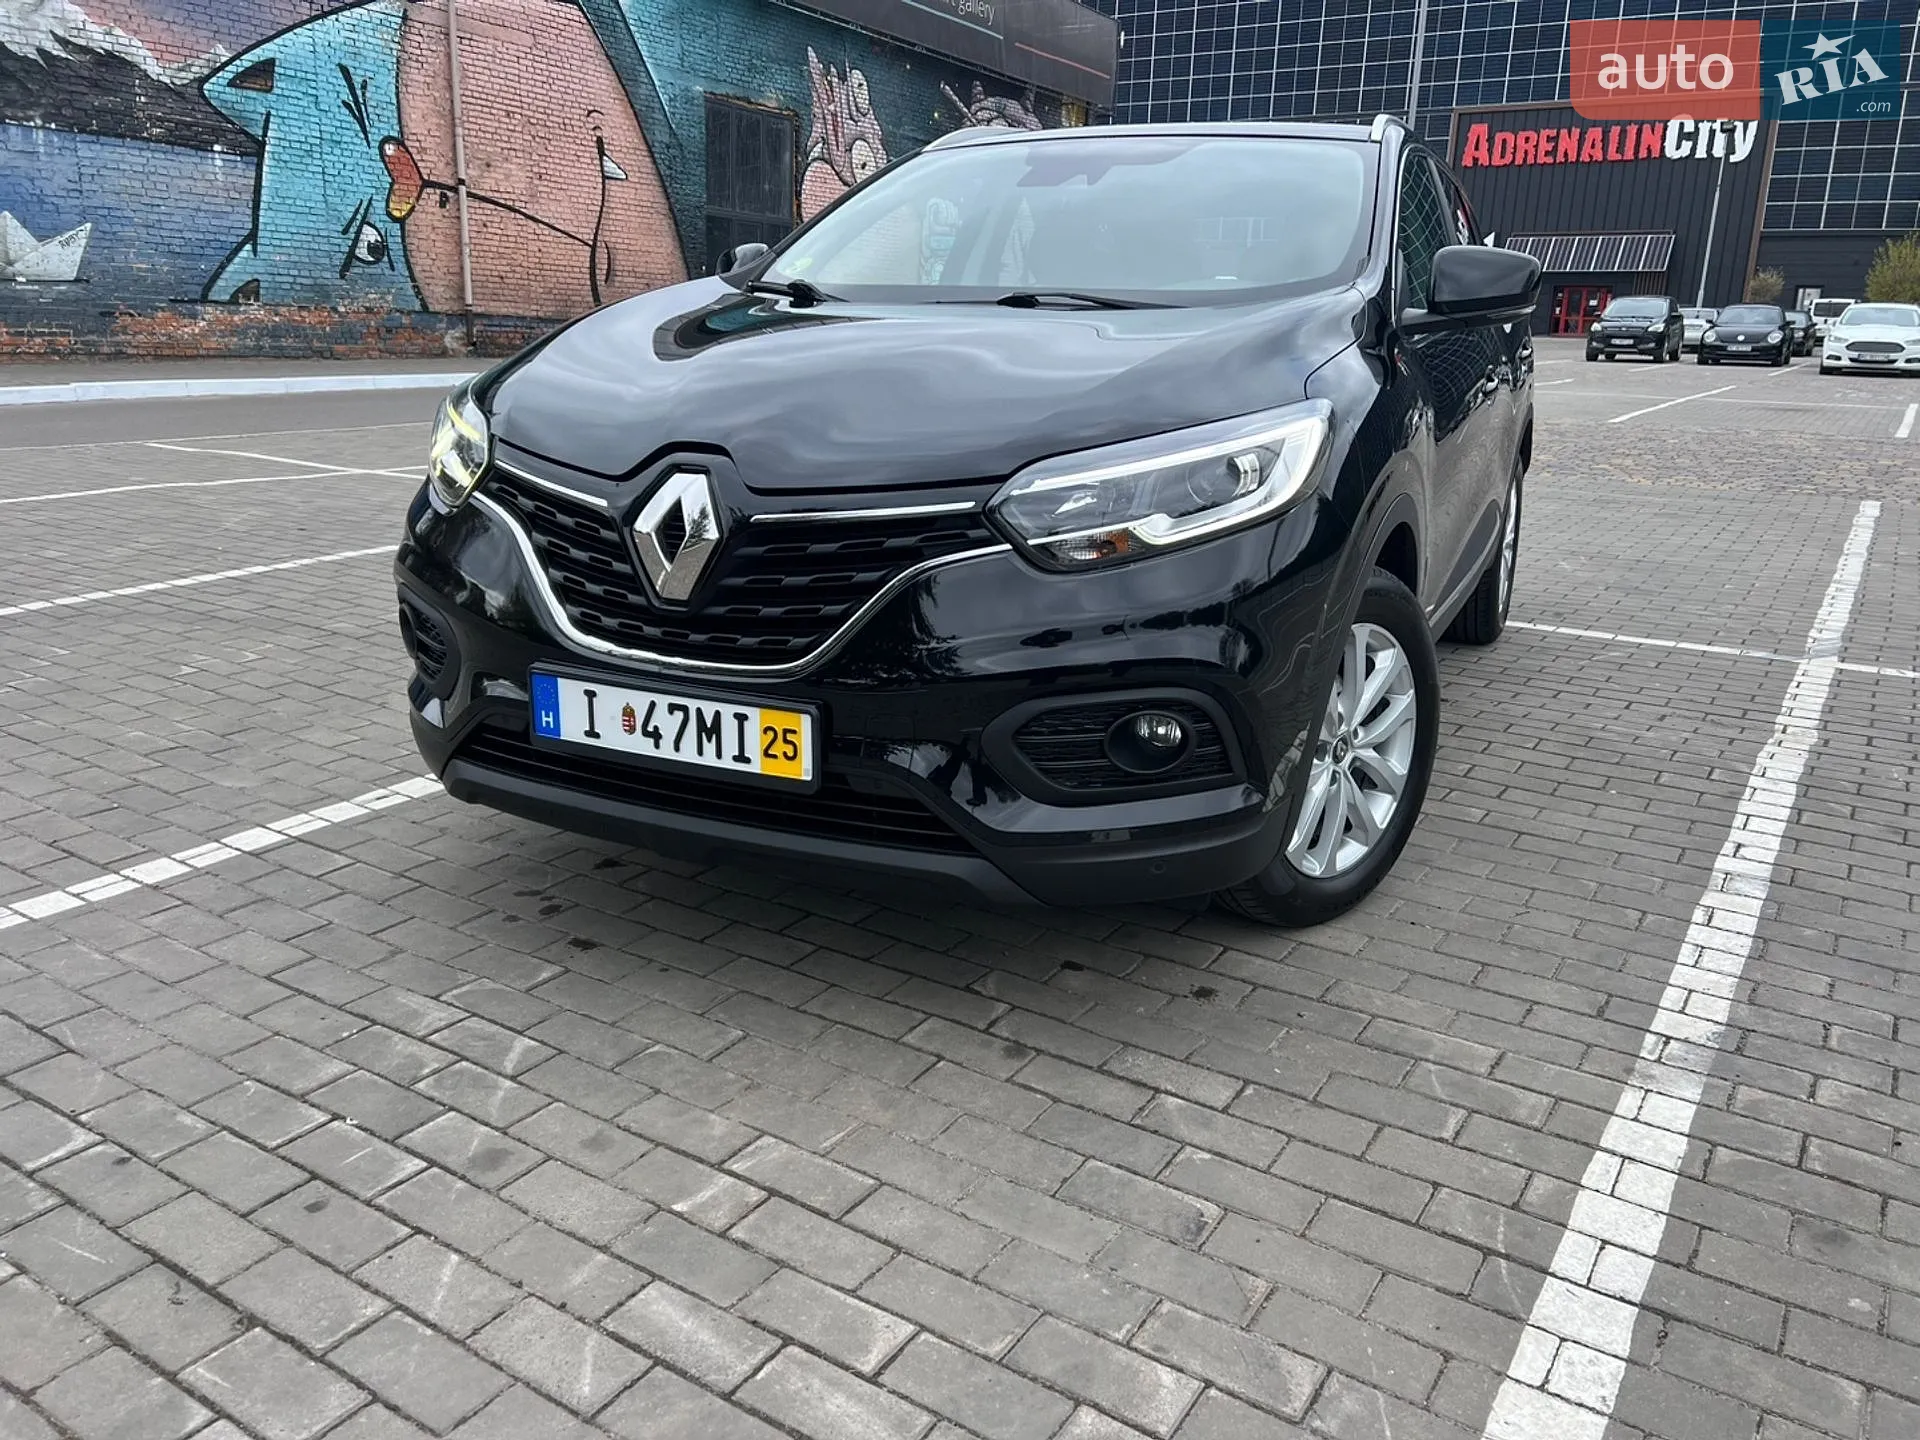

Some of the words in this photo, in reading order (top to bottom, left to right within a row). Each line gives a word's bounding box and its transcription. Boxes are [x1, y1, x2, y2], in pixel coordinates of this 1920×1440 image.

[541, 710, 554, 729] H
[641, 699, 752, 764] 47MI
[762, 725, 799, 762] 25
